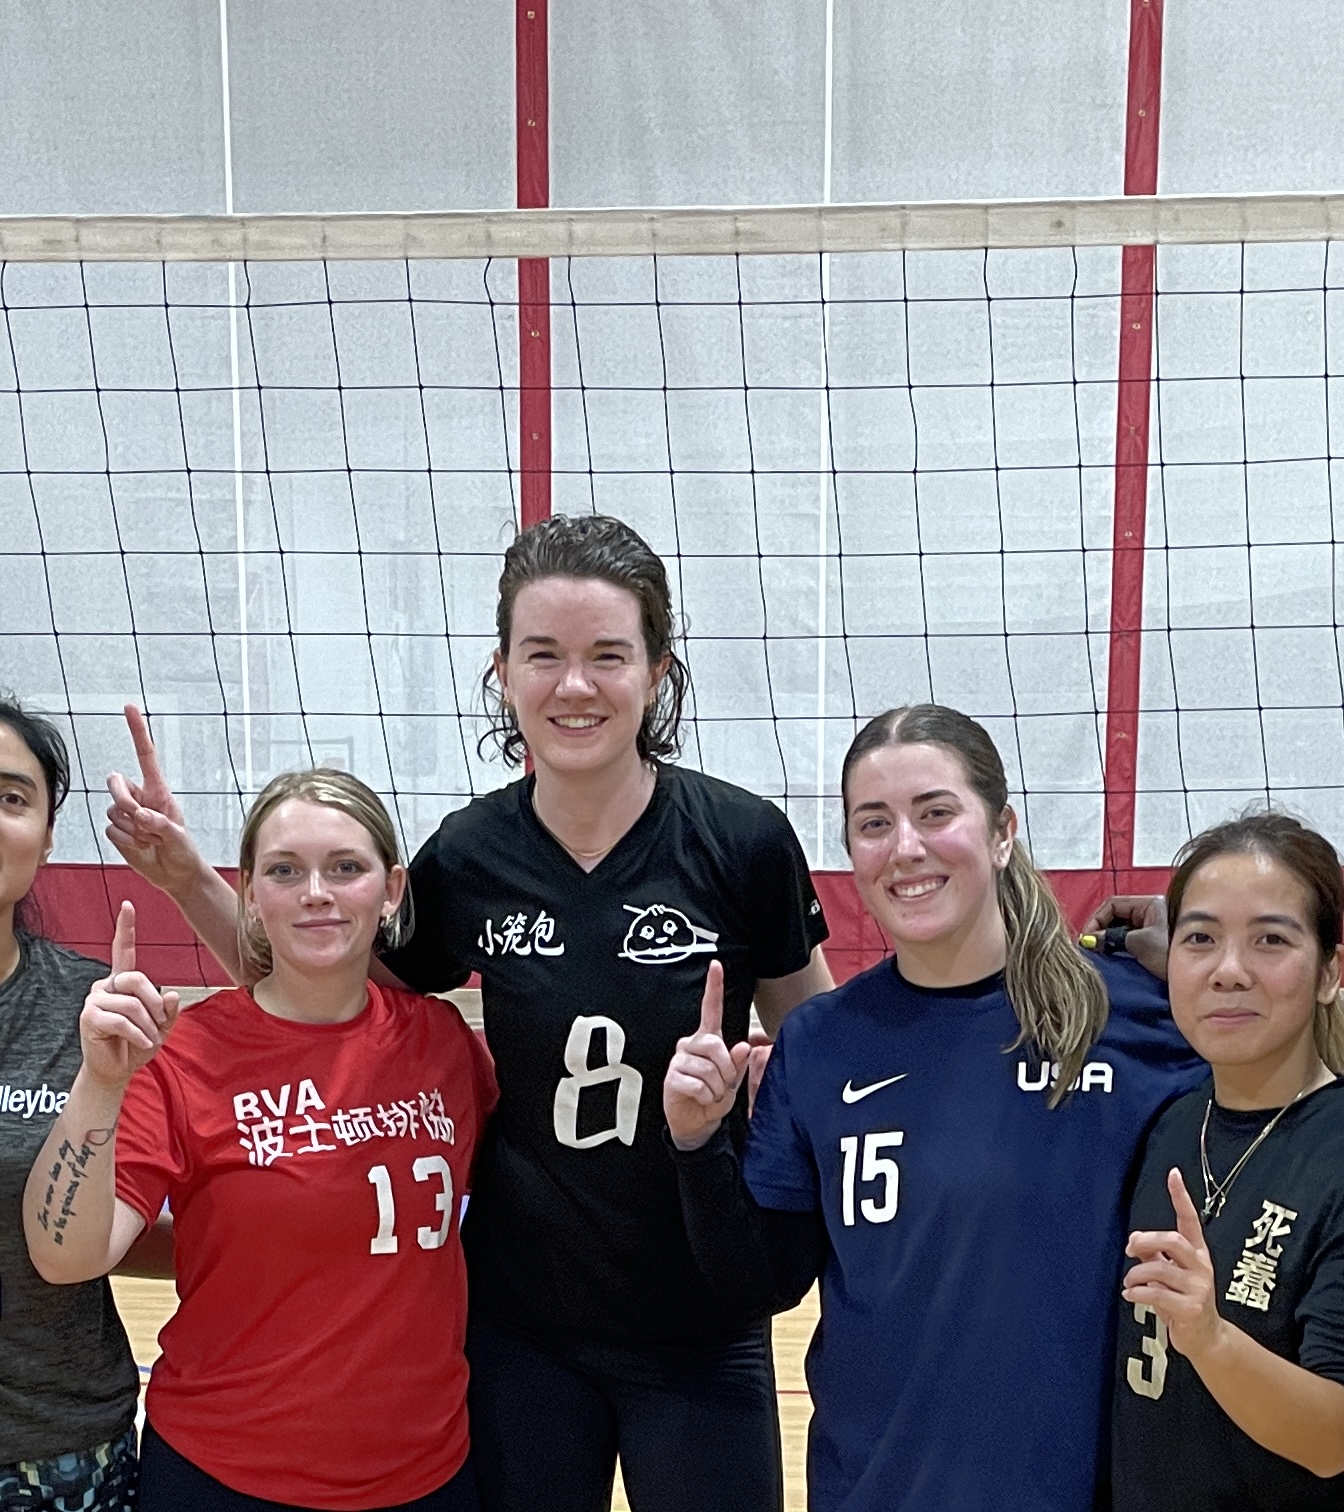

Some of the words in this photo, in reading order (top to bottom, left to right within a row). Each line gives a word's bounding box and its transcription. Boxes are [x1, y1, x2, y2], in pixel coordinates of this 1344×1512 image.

[477, 909, 565, 956] 小笼包
[554, 1015, 643, 1150] 8
[367, 1155, 454, 1255] 13
[839, 1130, 904, 1227] 15
[1125, 1302, 1169, 1401] 3
